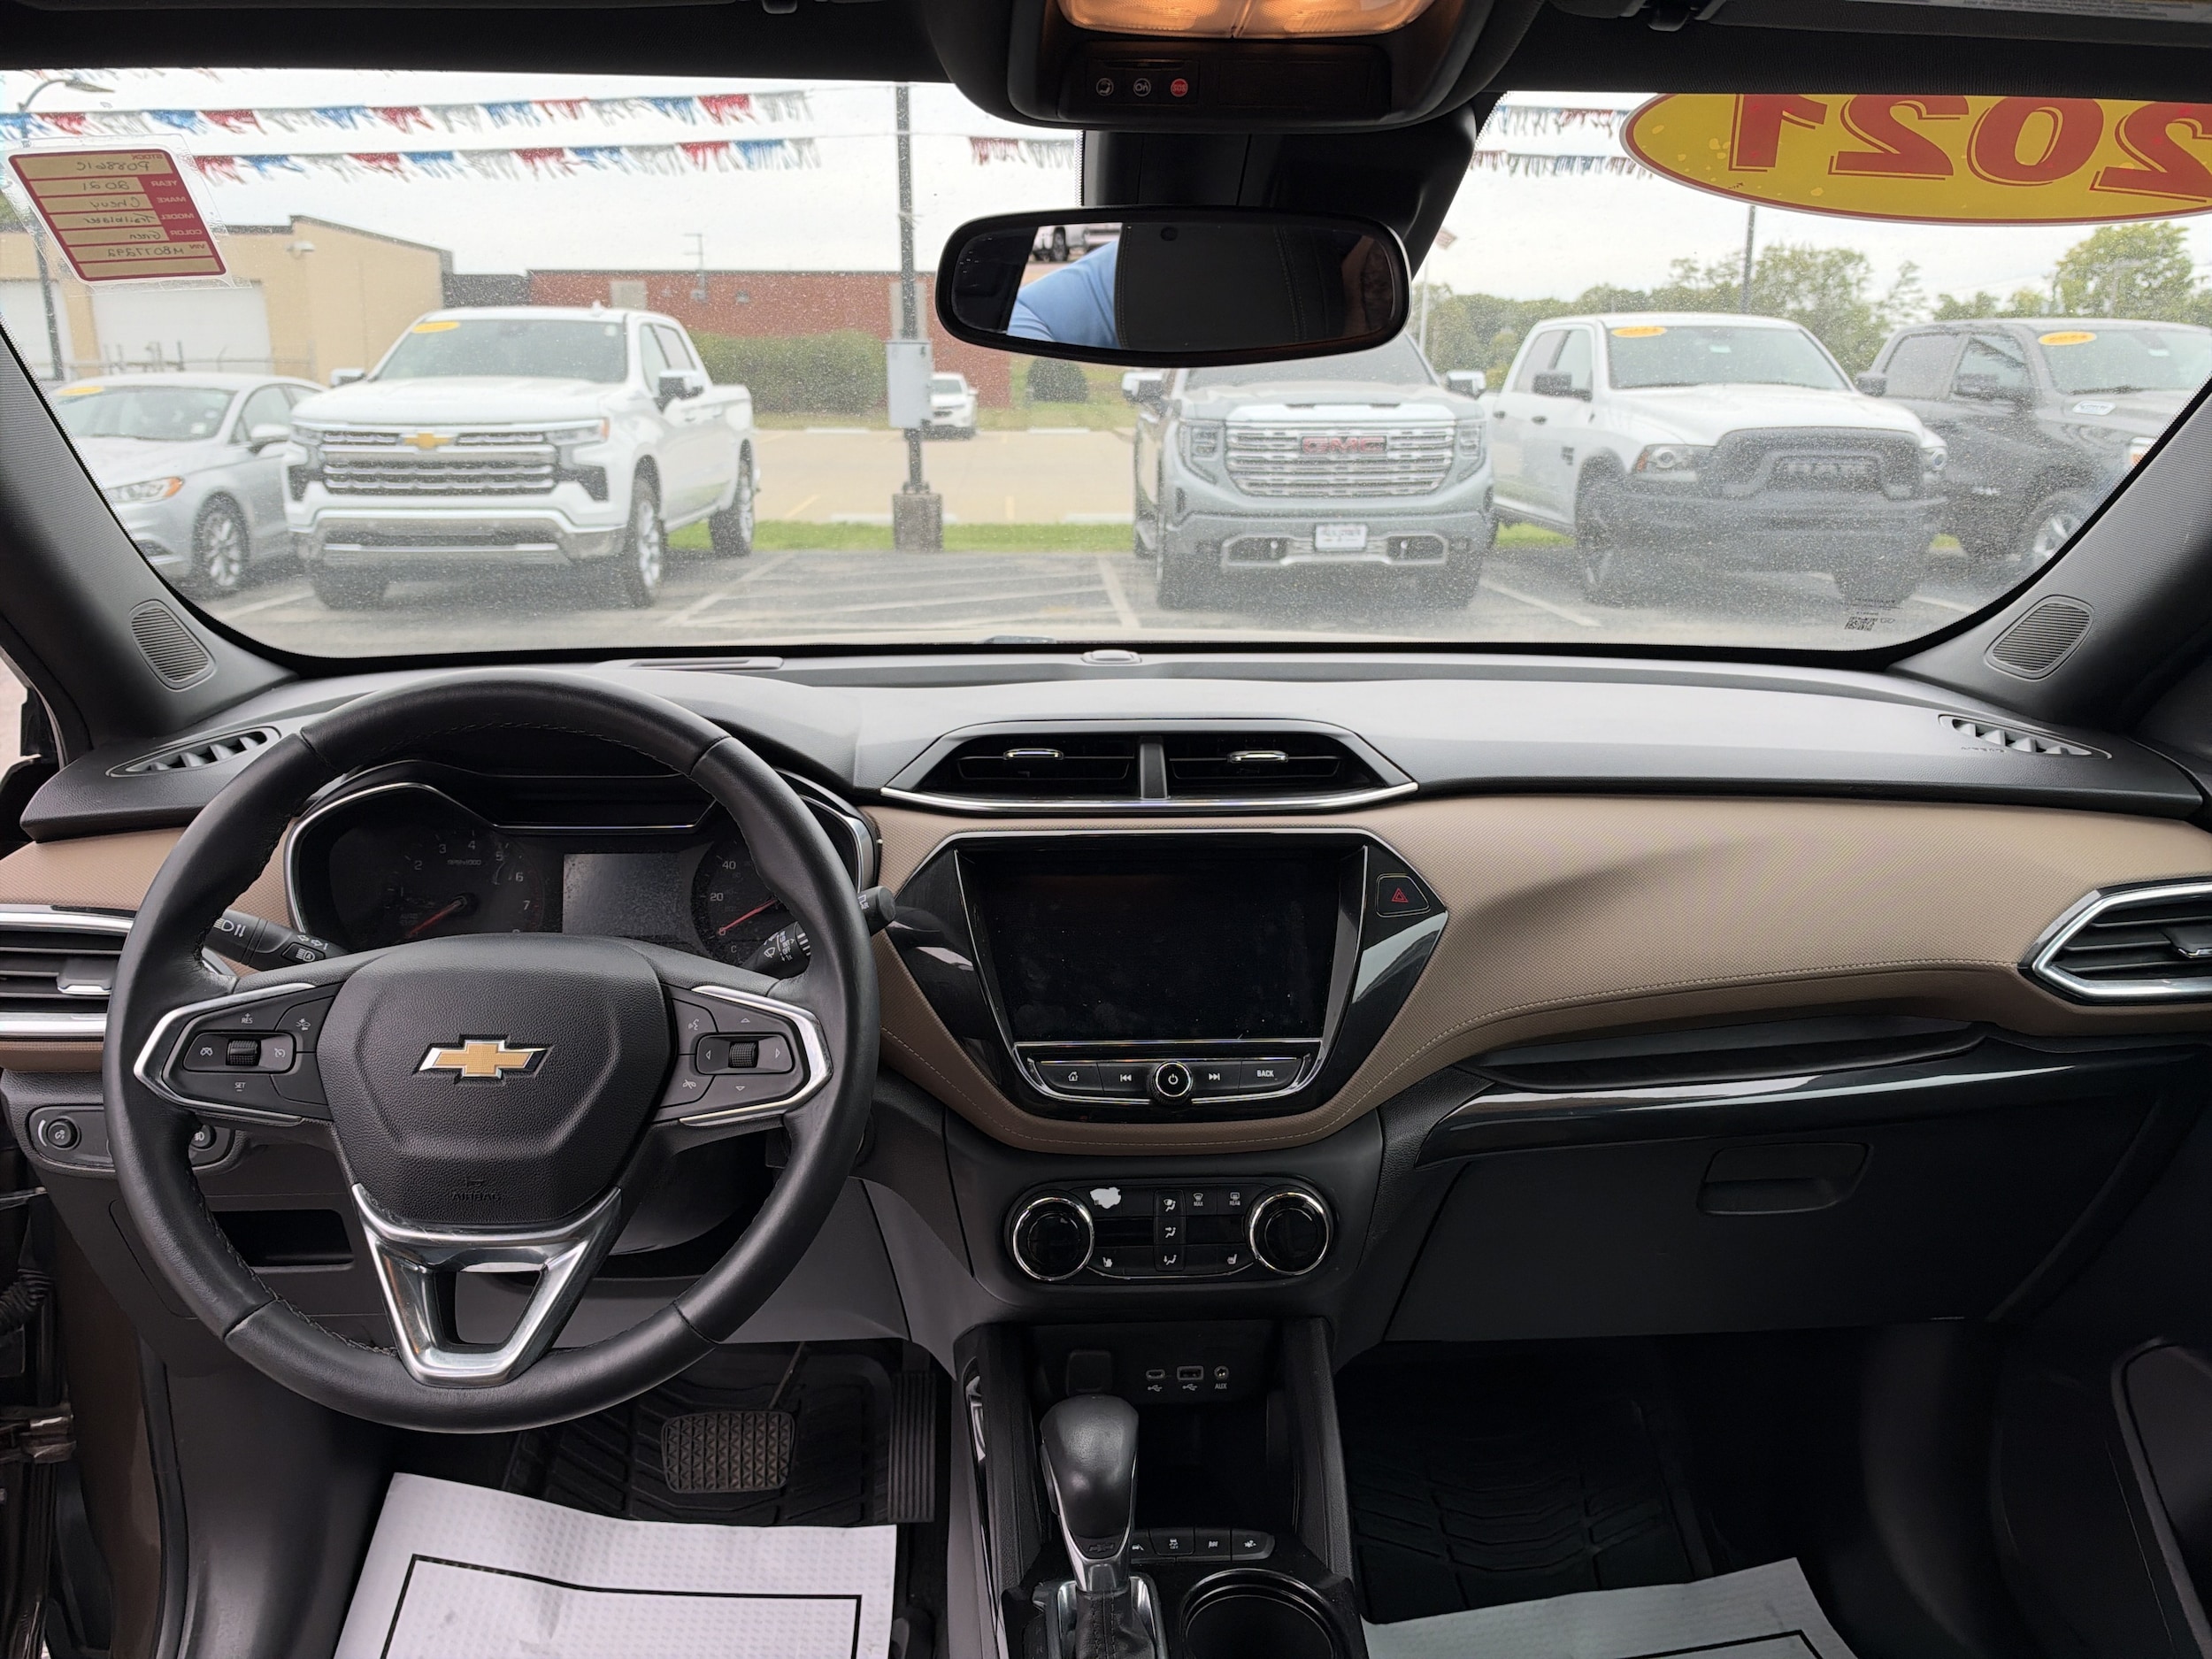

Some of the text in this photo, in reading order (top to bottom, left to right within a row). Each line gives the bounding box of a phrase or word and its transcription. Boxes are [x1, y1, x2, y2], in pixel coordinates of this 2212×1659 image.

[1172, 83, 1187, 93] SOS
[1302, 436, 1386, 453] GMC
[439, 843, 447, 855] 3
[468, 840, 477, 850] 4
[414, 859, 423, 871] 2
[722, 860, 737, 870] 40
[516, 872, 524, 882] 6
[710, 892, 724, 902] 20
[523, 900, 531, 910] 7
[730, 944, 738, 954] C
